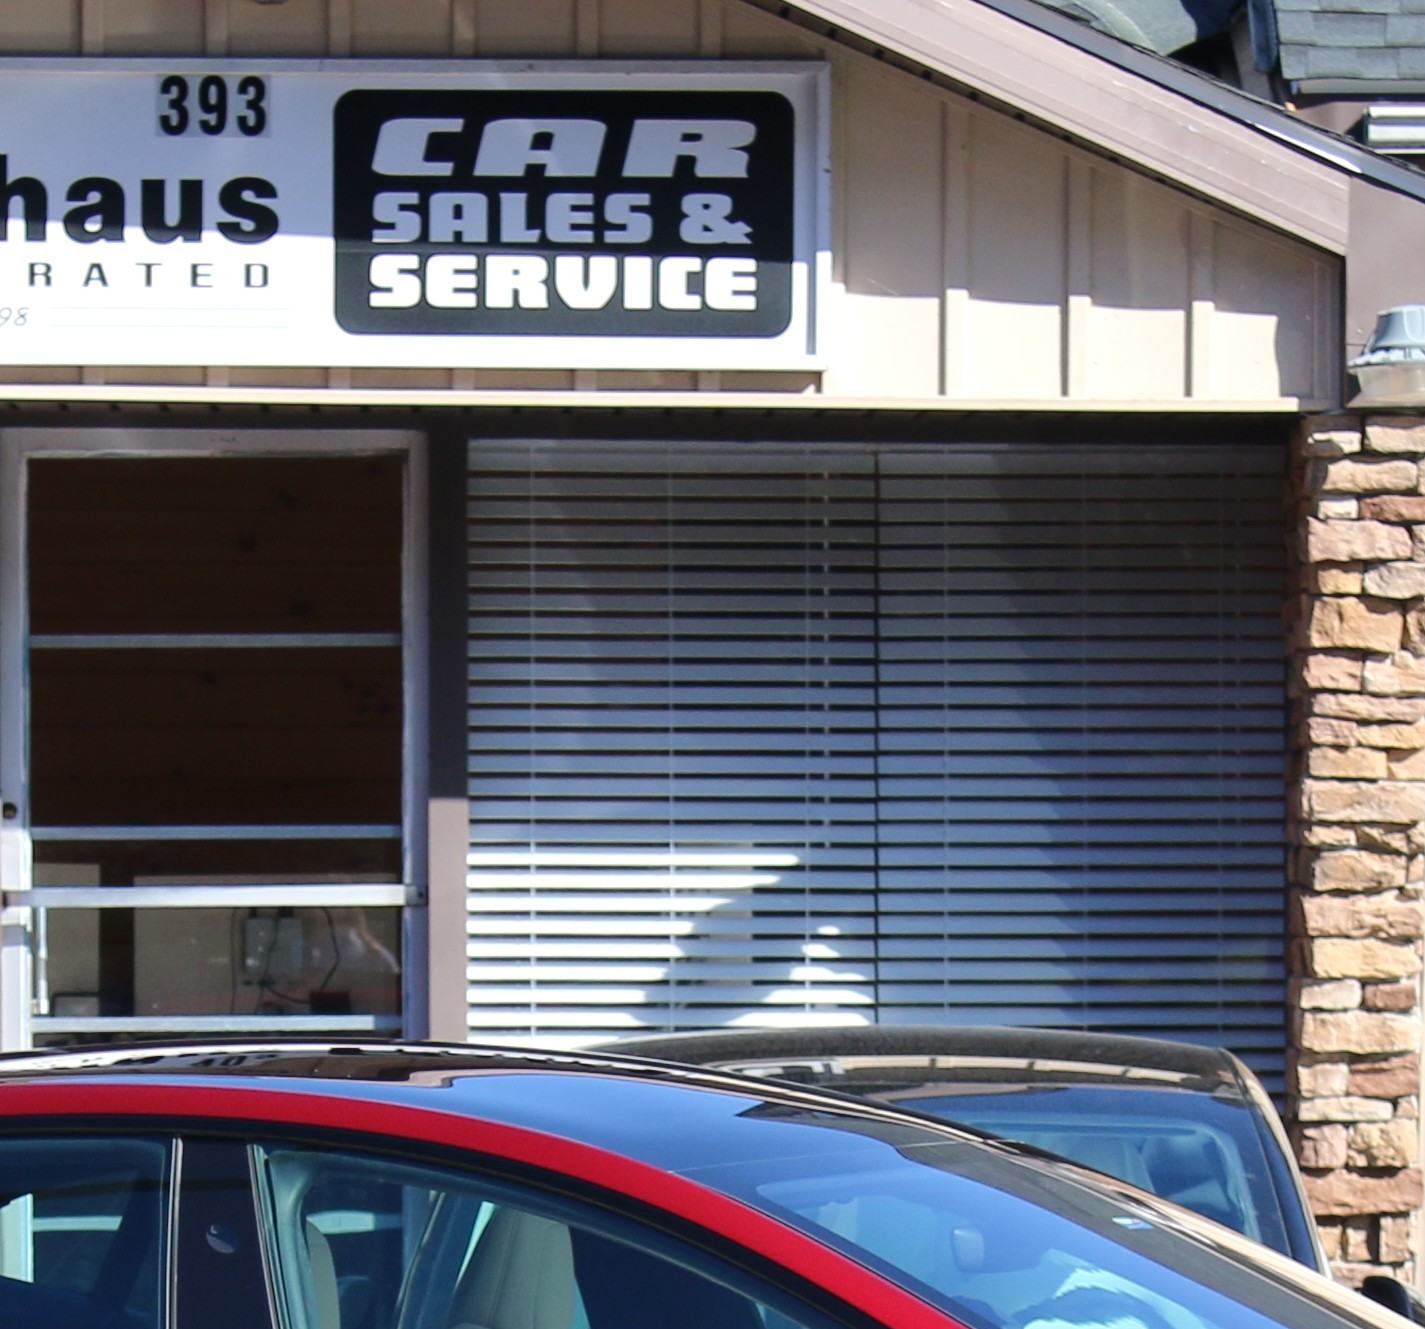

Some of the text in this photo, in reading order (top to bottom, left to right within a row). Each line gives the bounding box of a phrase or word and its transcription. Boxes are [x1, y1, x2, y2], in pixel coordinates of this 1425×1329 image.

[159, 75, 266, 136] 393
[371, 118, 758, 178] CAR
[371, 192, 754, 244] SALES &
[369, 253, 759, 311] SERVICE
